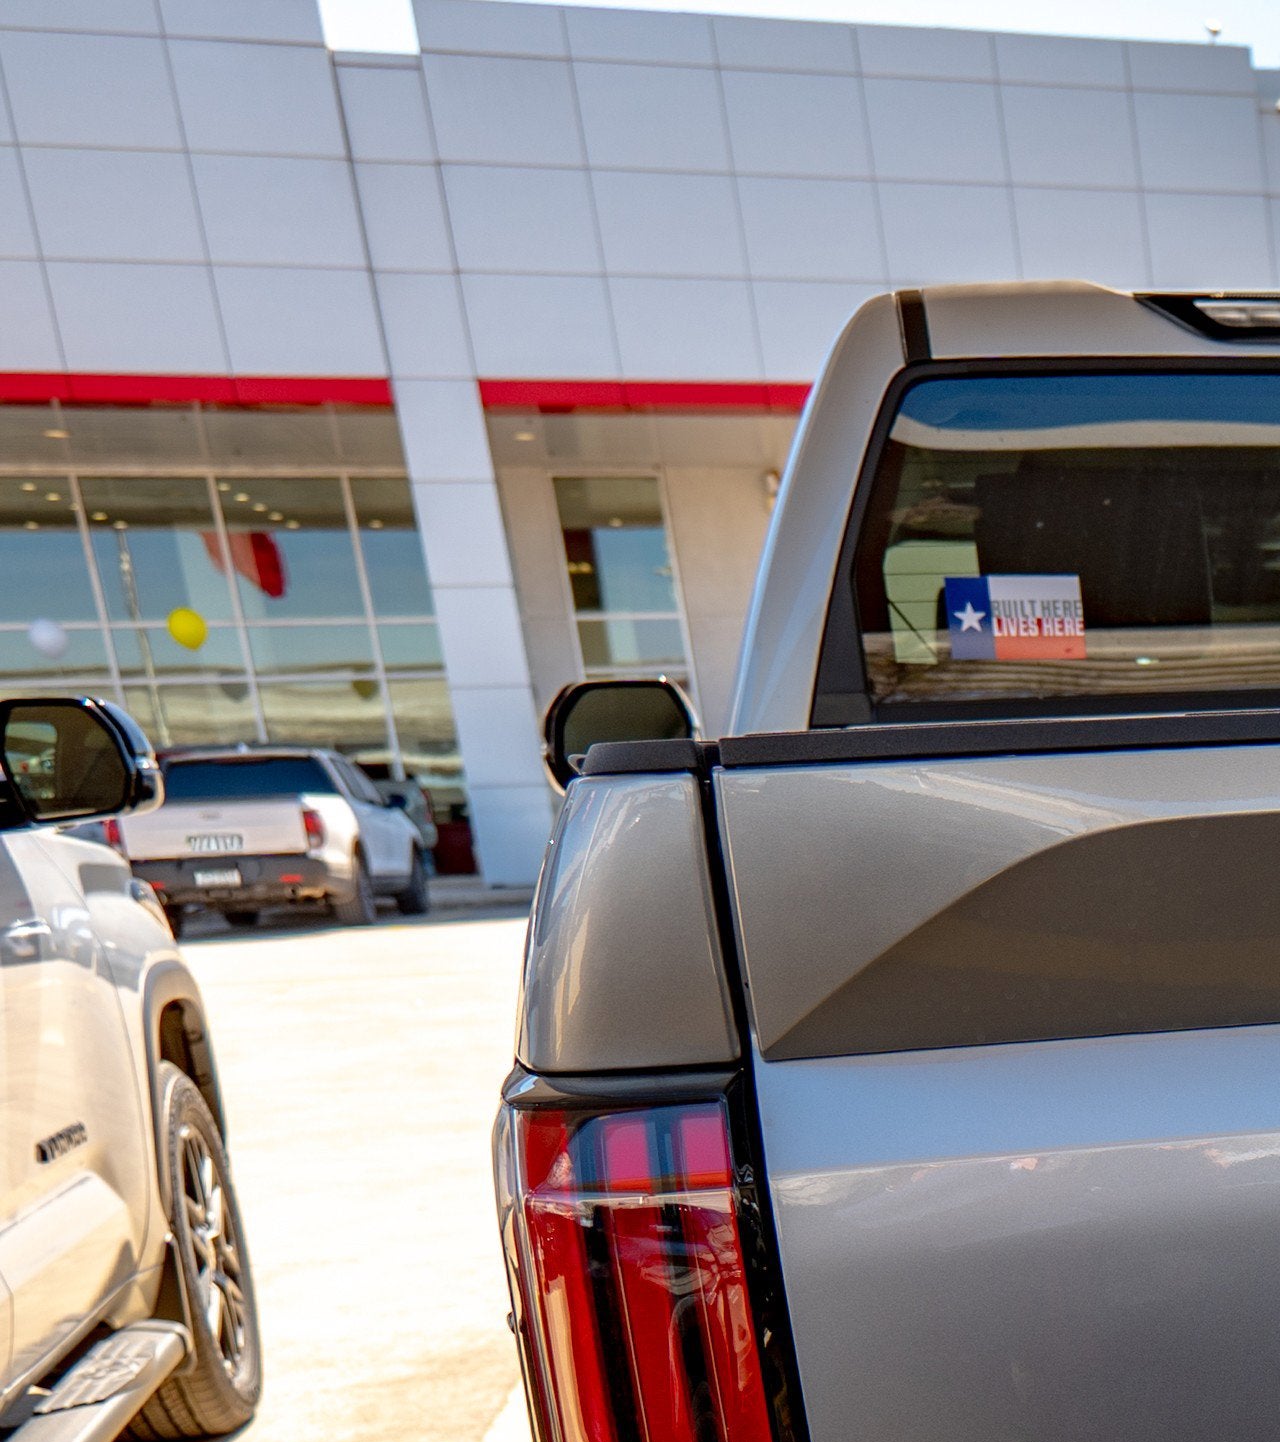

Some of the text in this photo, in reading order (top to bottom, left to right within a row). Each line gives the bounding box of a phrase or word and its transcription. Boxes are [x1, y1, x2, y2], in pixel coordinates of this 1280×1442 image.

[992, 600, 1083, 618] BUILT HERE
[993, 618, 1085, 637] LIVES HERE
